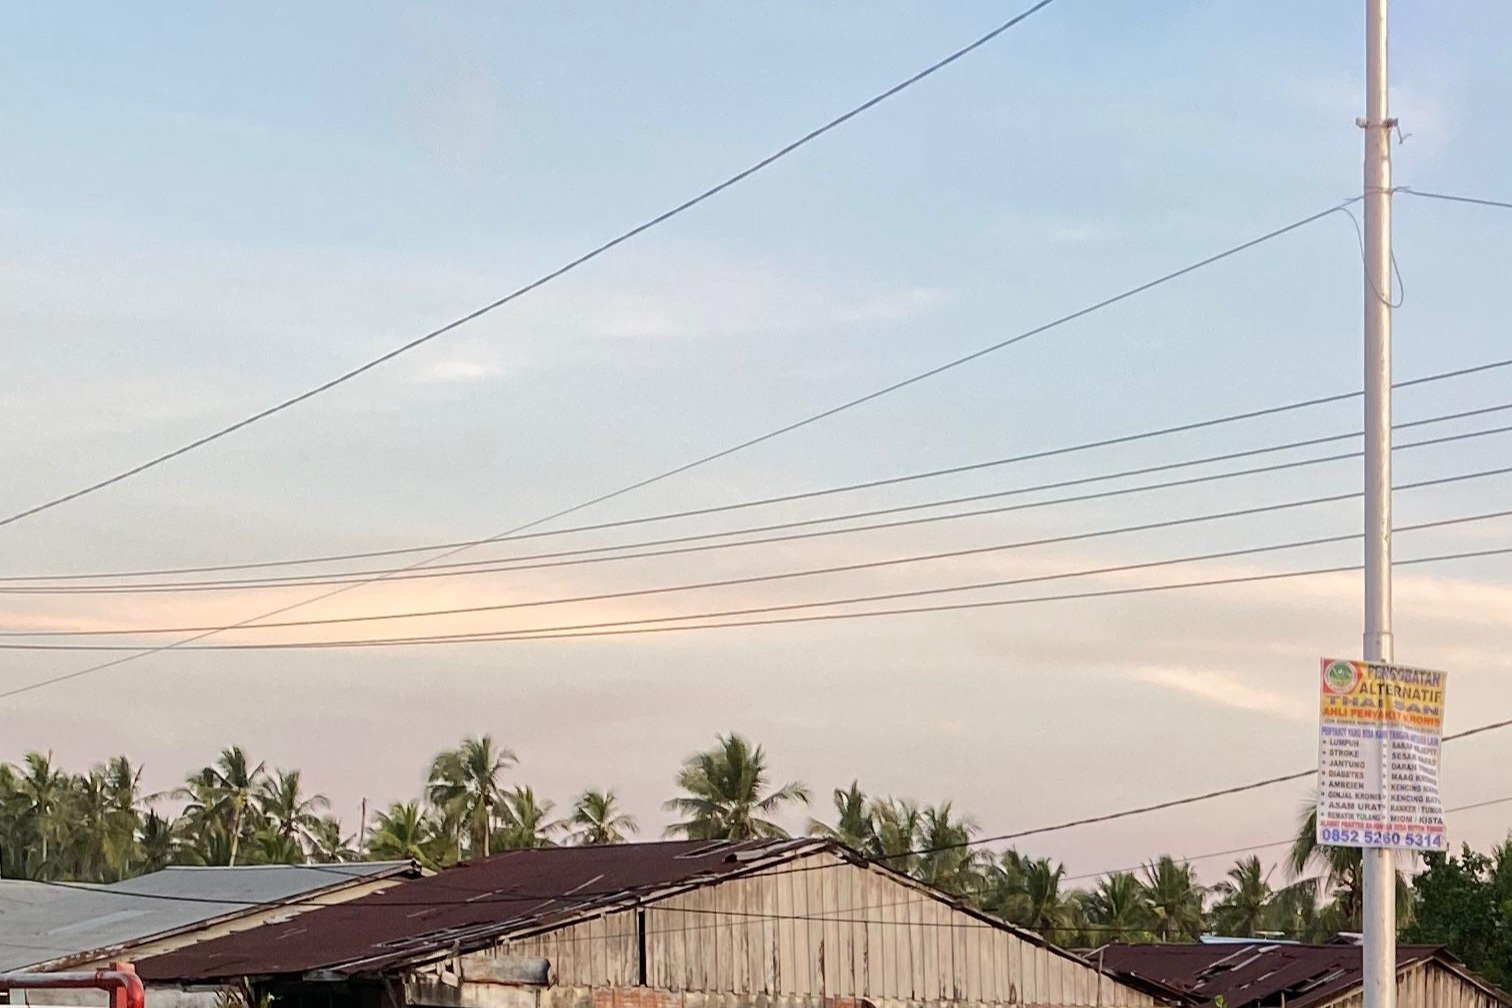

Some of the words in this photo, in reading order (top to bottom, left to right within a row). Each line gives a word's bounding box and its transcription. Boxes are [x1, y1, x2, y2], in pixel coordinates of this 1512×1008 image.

[1359, 682, 1442, 703] ALTERNATIF
[1323, 707, 1348, 718] AHLI
[1350, 708, 1401, 722] PENYAKIT
[1403, 712, 1441, 728] KRONIS
[1329, 738, 1359, 748] LUMPUH
[1329, 749, 1359, 759] STROKE
[1391, 751, 1417, 761] SESAK
[1328, 760, 1366, 769] JANTUNG
[1391, 762, 1417, 772] DARAH
[1328, 769, 1365, 780] DIABETES
[1328, 781, 1365, 790] AMBEIEN
[1390, 783, 1422, 794] KENCING
[1328, 791, 1353, 801] GINJAL
[1354, 792, 1382, 802] KRONIS
[1390, 794, 1424, 804] KENCING
[1328, 801, 1355, 810] ASAM
[1357, 802, 1382, 812] URAT
[1356, 812, 1381, 822] TULANG
[1390, 814, 1413, 823] MIOM
[1419, 816, 1444, 826] KISTA
[1321, 828, 1359, 843] 0852
[1364, 831, 1401, 846] 5260
[1405, 833, 1442, 848] 5314
